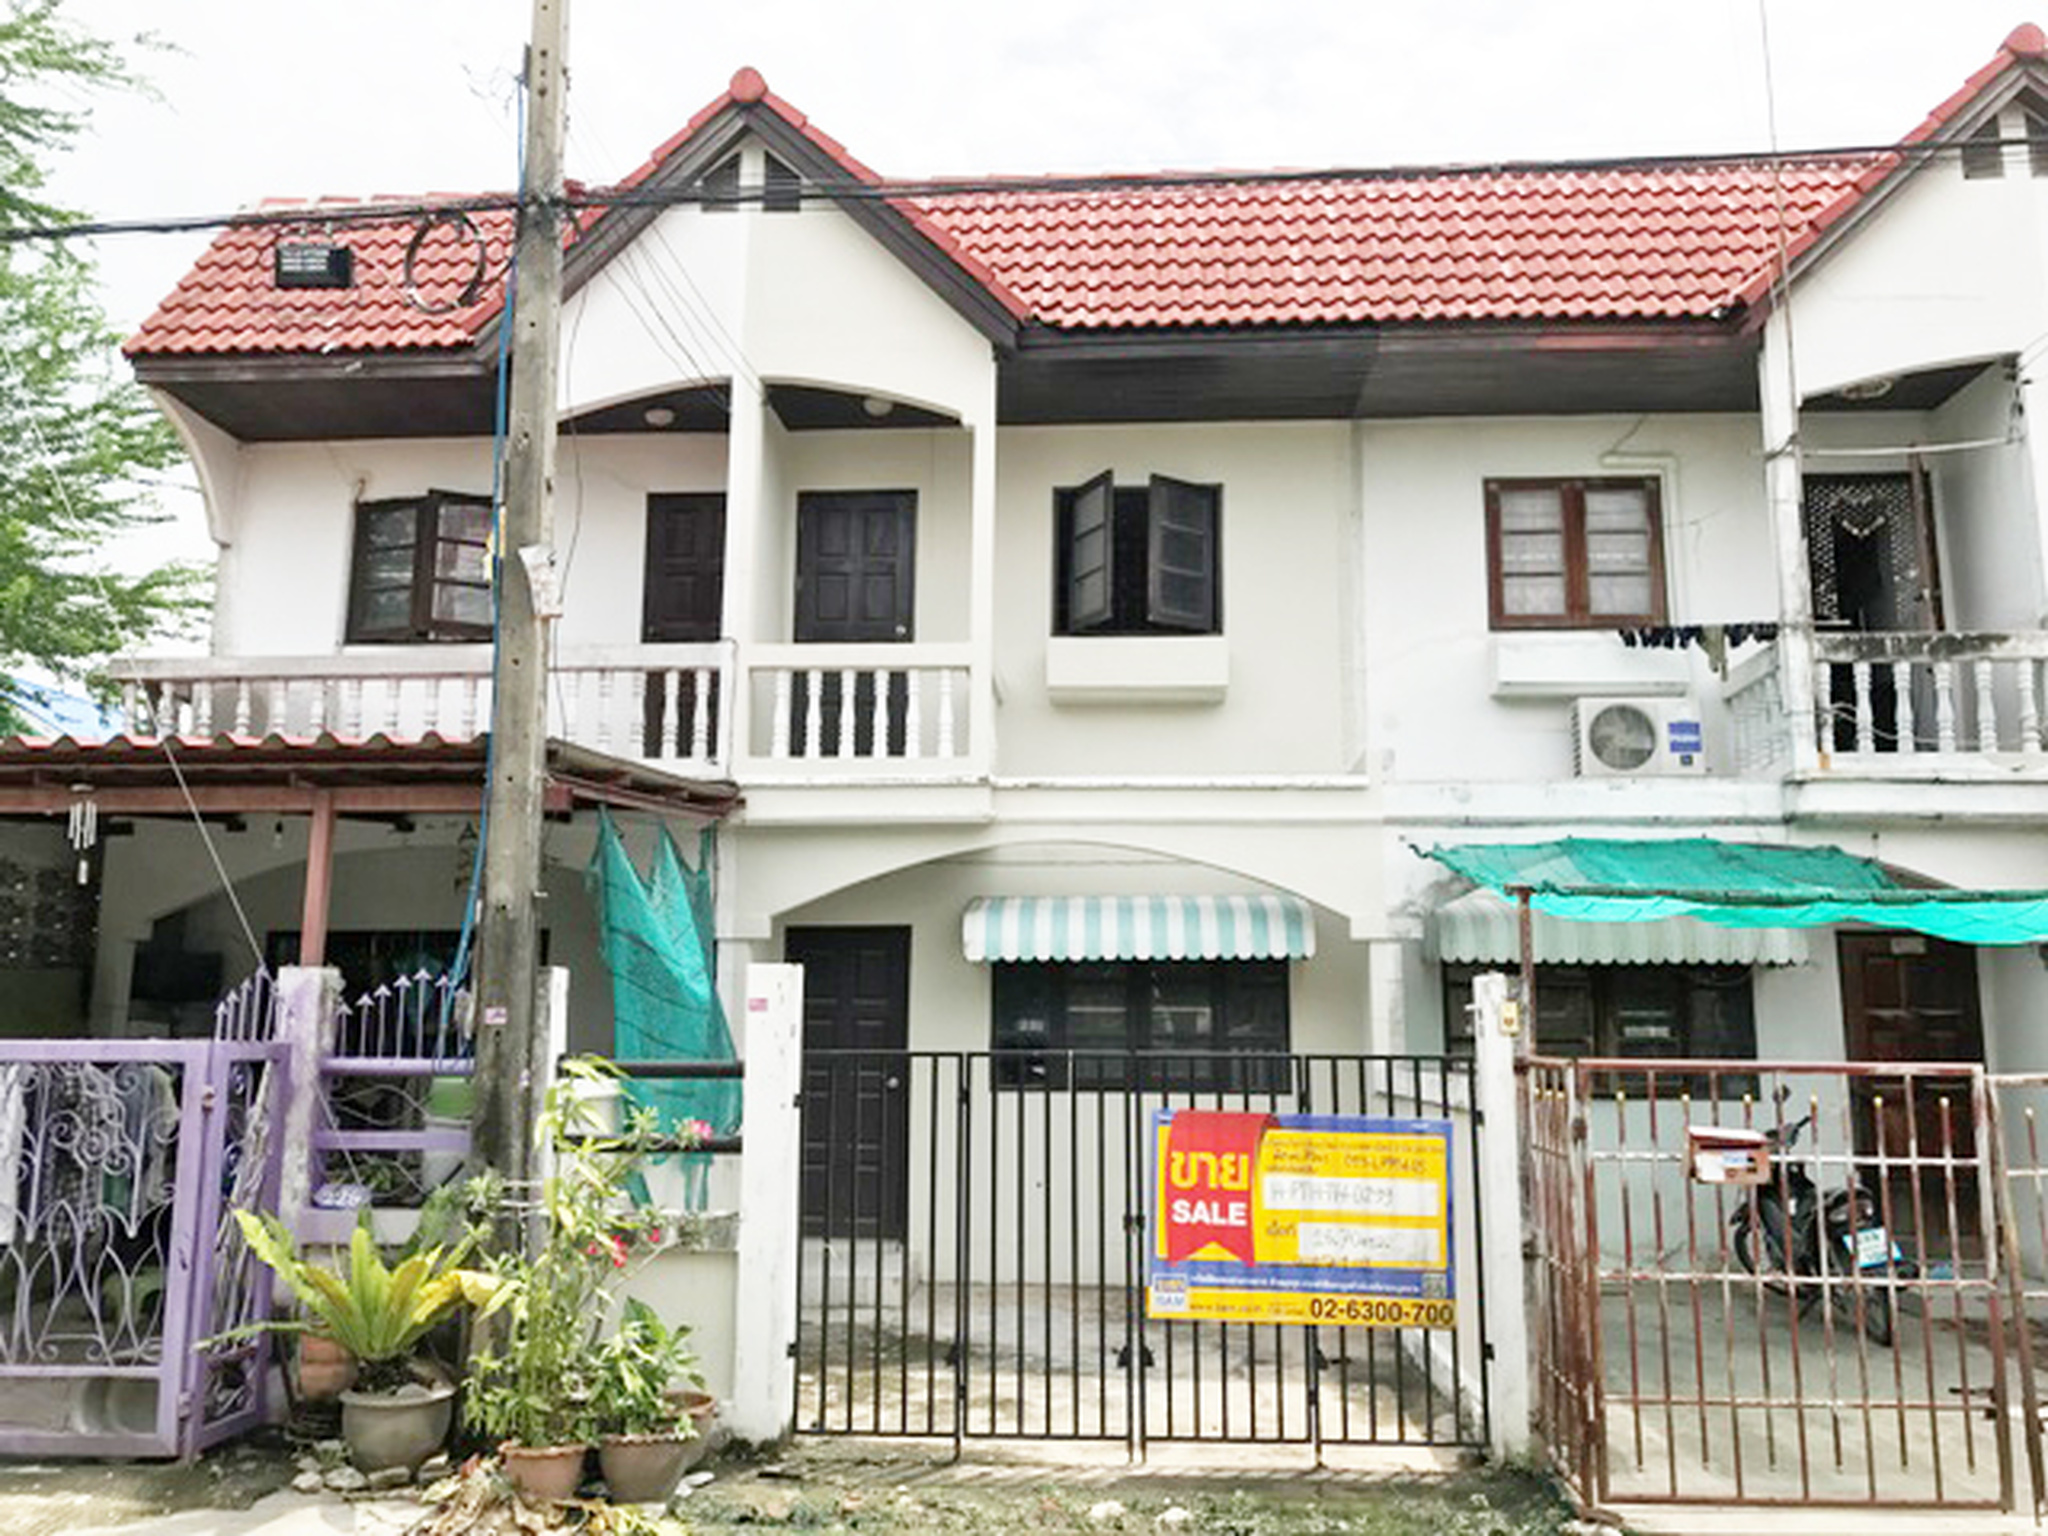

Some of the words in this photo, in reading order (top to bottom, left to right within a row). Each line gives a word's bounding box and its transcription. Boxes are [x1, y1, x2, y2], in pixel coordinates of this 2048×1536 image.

[1170, 1151, 1249, 1190] ขาย
[1172, 1199, 1248, 1226] SALE
[1310, 1297, 1454, 1325] 02-6300-700
